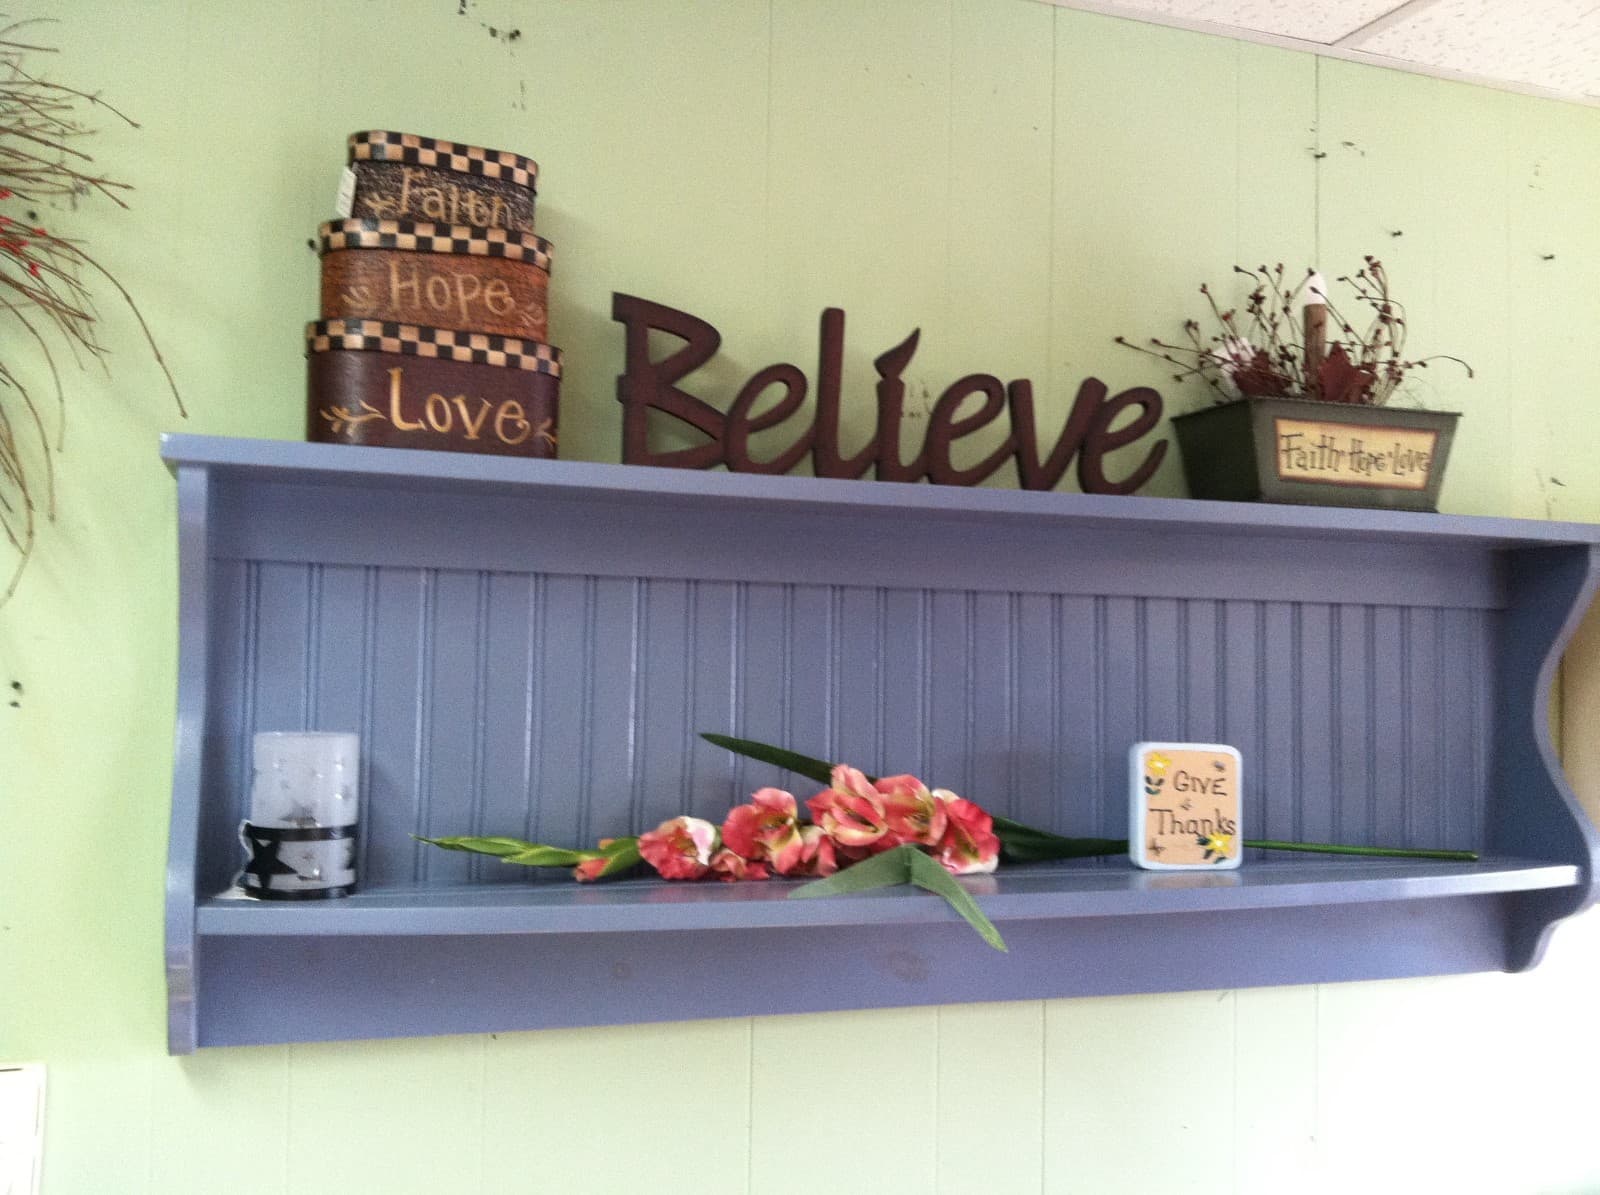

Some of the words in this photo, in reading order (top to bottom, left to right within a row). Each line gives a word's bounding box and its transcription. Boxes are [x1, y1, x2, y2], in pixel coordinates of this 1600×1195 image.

[401, 167, 514, 228] Faith
[387, 260, 516, 325] Hope
[387, 367, 531, 445] Love
[612, 290, 1169, 496] Believe
[1280, 432, 1340, 473] Faith
[1148, 807, 1236, 838] Thanks
